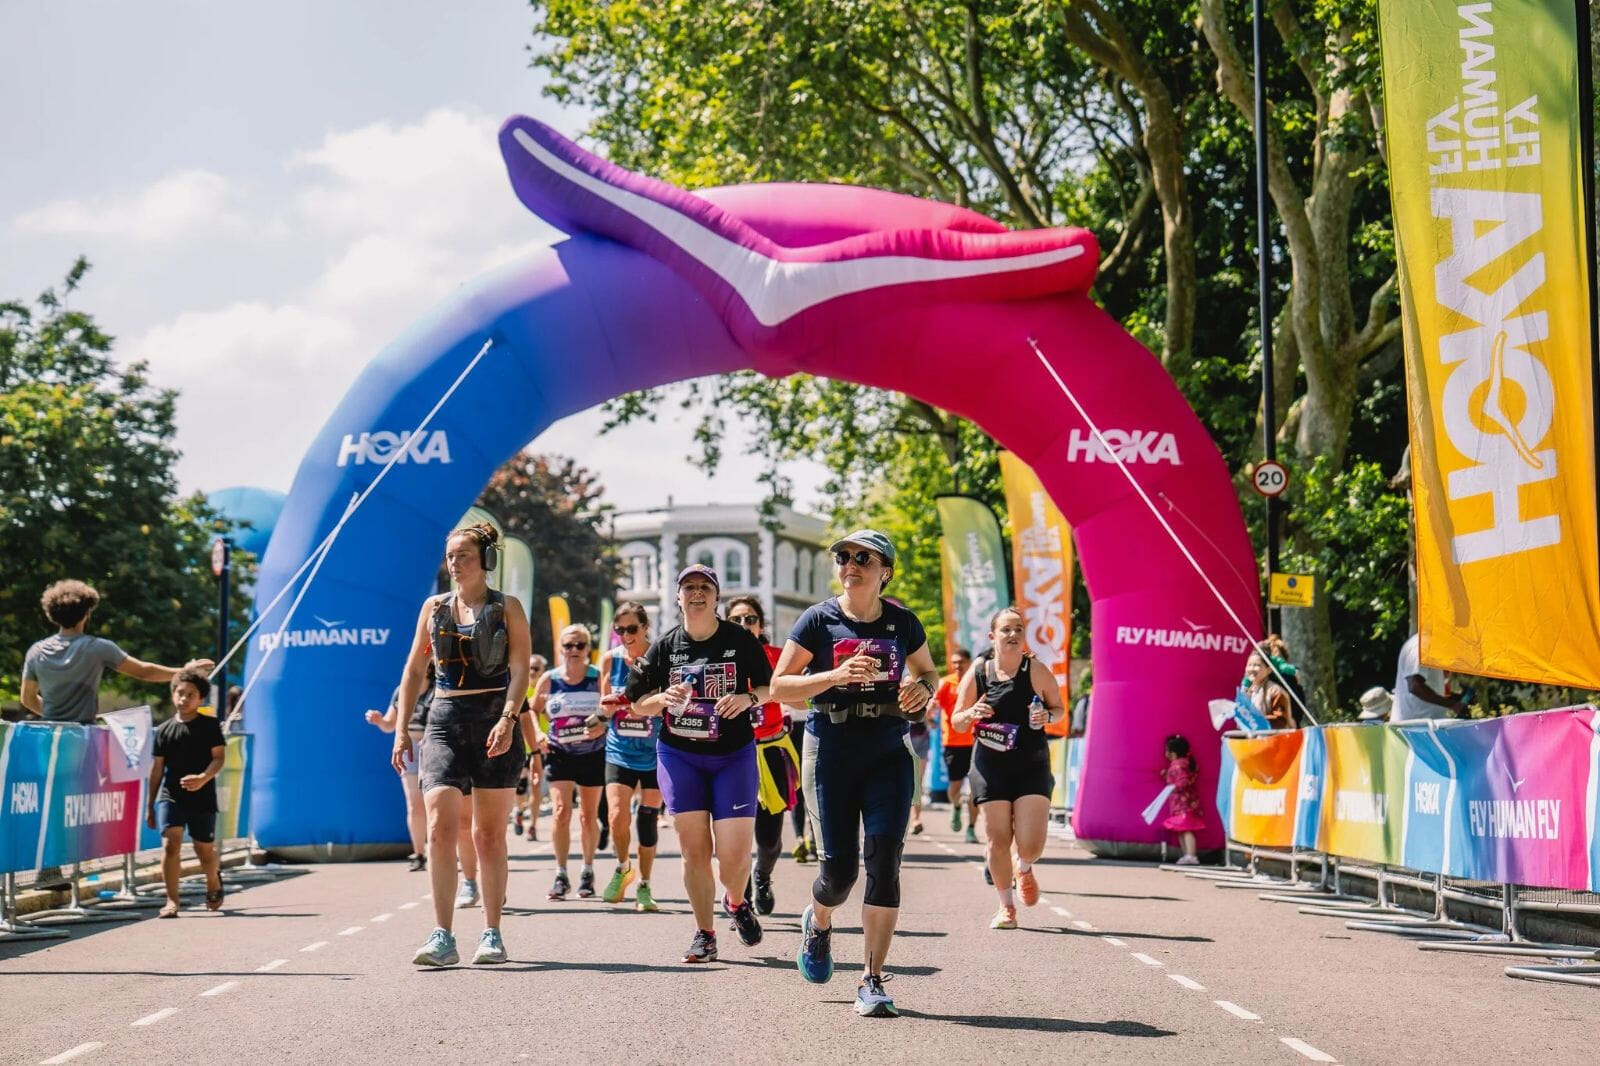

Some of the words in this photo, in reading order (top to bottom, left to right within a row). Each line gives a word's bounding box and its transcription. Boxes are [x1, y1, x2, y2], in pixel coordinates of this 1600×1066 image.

[336, 430, 450, 467] HOKA
[1067, 428, 1181, 465] HOKA
[1258, 471, 1283, 486] 20
[259, 631, 282, 652] FLY
[283, 628, 358, 648] HUMAN
[360, 628, 390, 645] FLY
[1116, 626, 1145, 645] FLY
[1145, 628, 1221, 651] HUMAN
[1223, 635, 1248, 654] FLY
[674, 717, 682, 725] F
[681, 718, 703, 727] 3355
[10, 781, 39, 815] HOKA
[64, 794, 80, 828] FLY
[80, 791, 112, 826] HUMAN
[112, 790, 127, 821] FLY
[1414, 782, 1441, 815] HOKA
[1469, 800, 1487, 837] FLY
[1488, 800, 1537, 839] HUMAN
[1538, 800, 1561, 840] FLY
